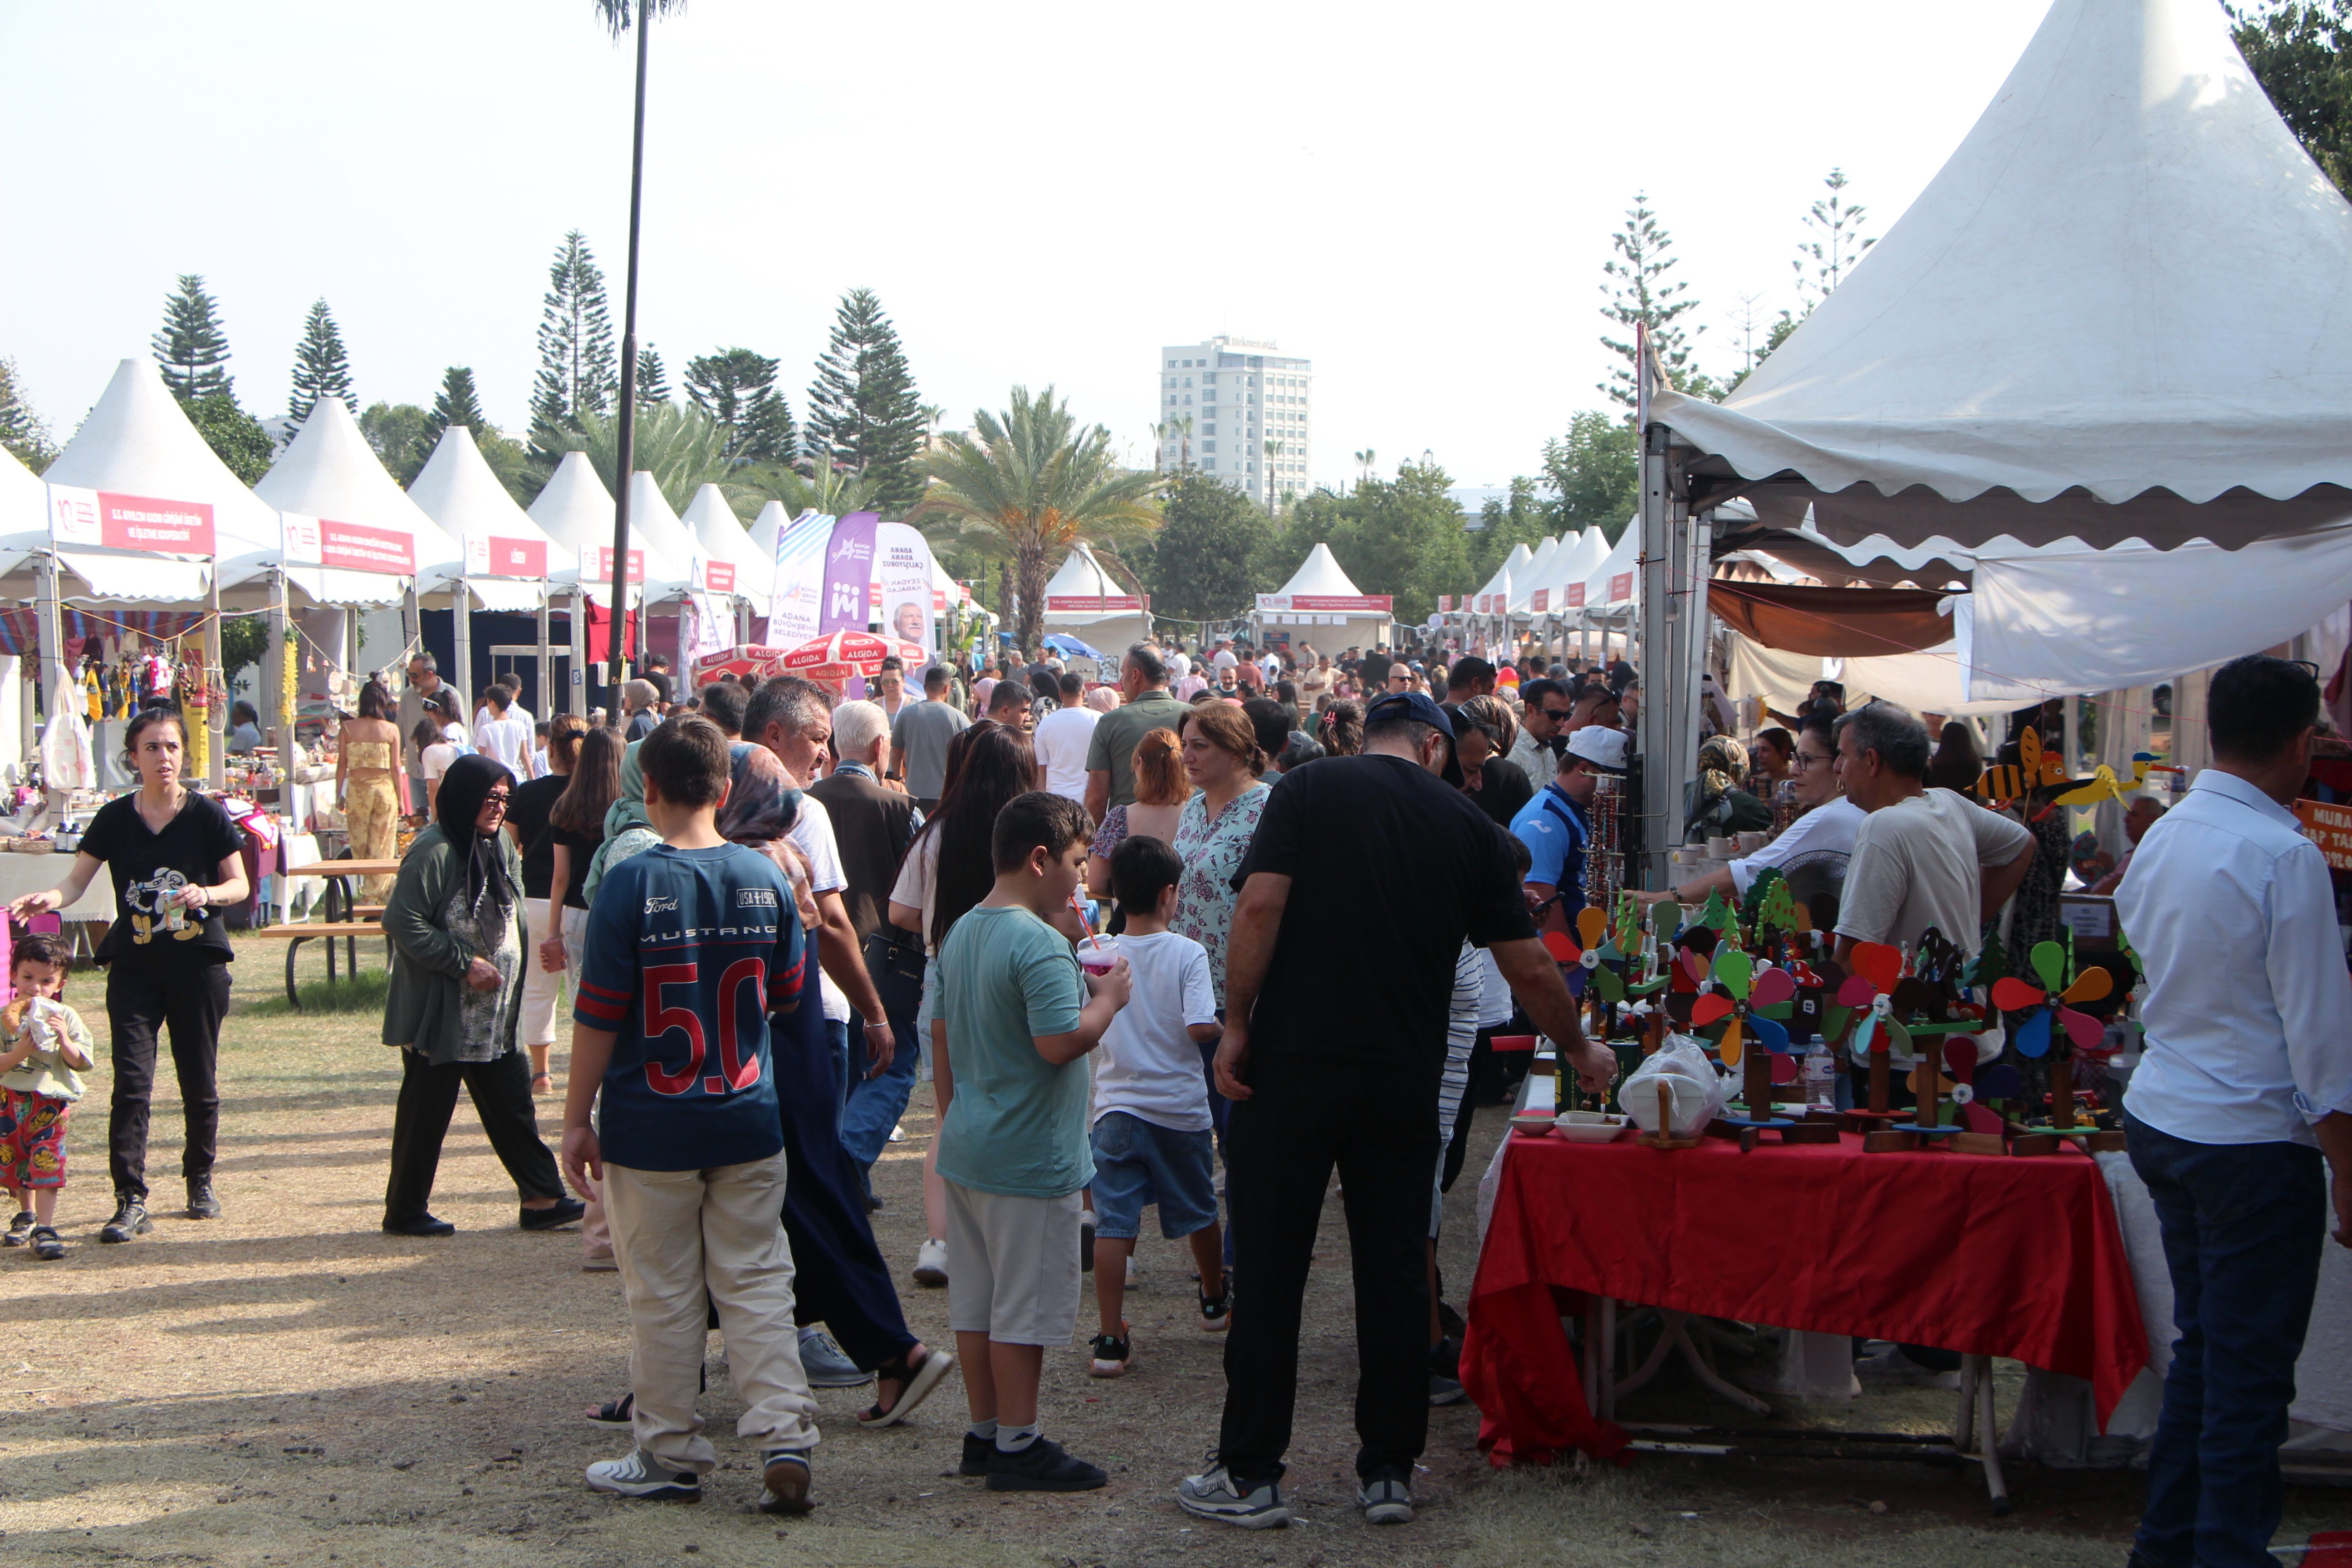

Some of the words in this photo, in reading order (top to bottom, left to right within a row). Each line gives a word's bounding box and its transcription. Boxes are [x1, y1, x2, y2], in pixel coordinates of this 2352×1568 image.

[511, 548, 526, 564] LÖSEV
[782, 612, 810, 622] ADANA
[773, 618, 818, 632] BÜYÜKŞEHİR
[774, 628, 815, 640] BELEDİYESİ
[706, 652, 728, 664] ALGIDA
[791, 654, 820, 666] ALGIDA
[847, 649, 879, 659] ALGIDA
[644, 896, 678, 914] Ford
[740, 892, 754, 905] USA
[641, 926, 777, 942] MUSTANG
[643, 957, 767, 1095] 5.0
